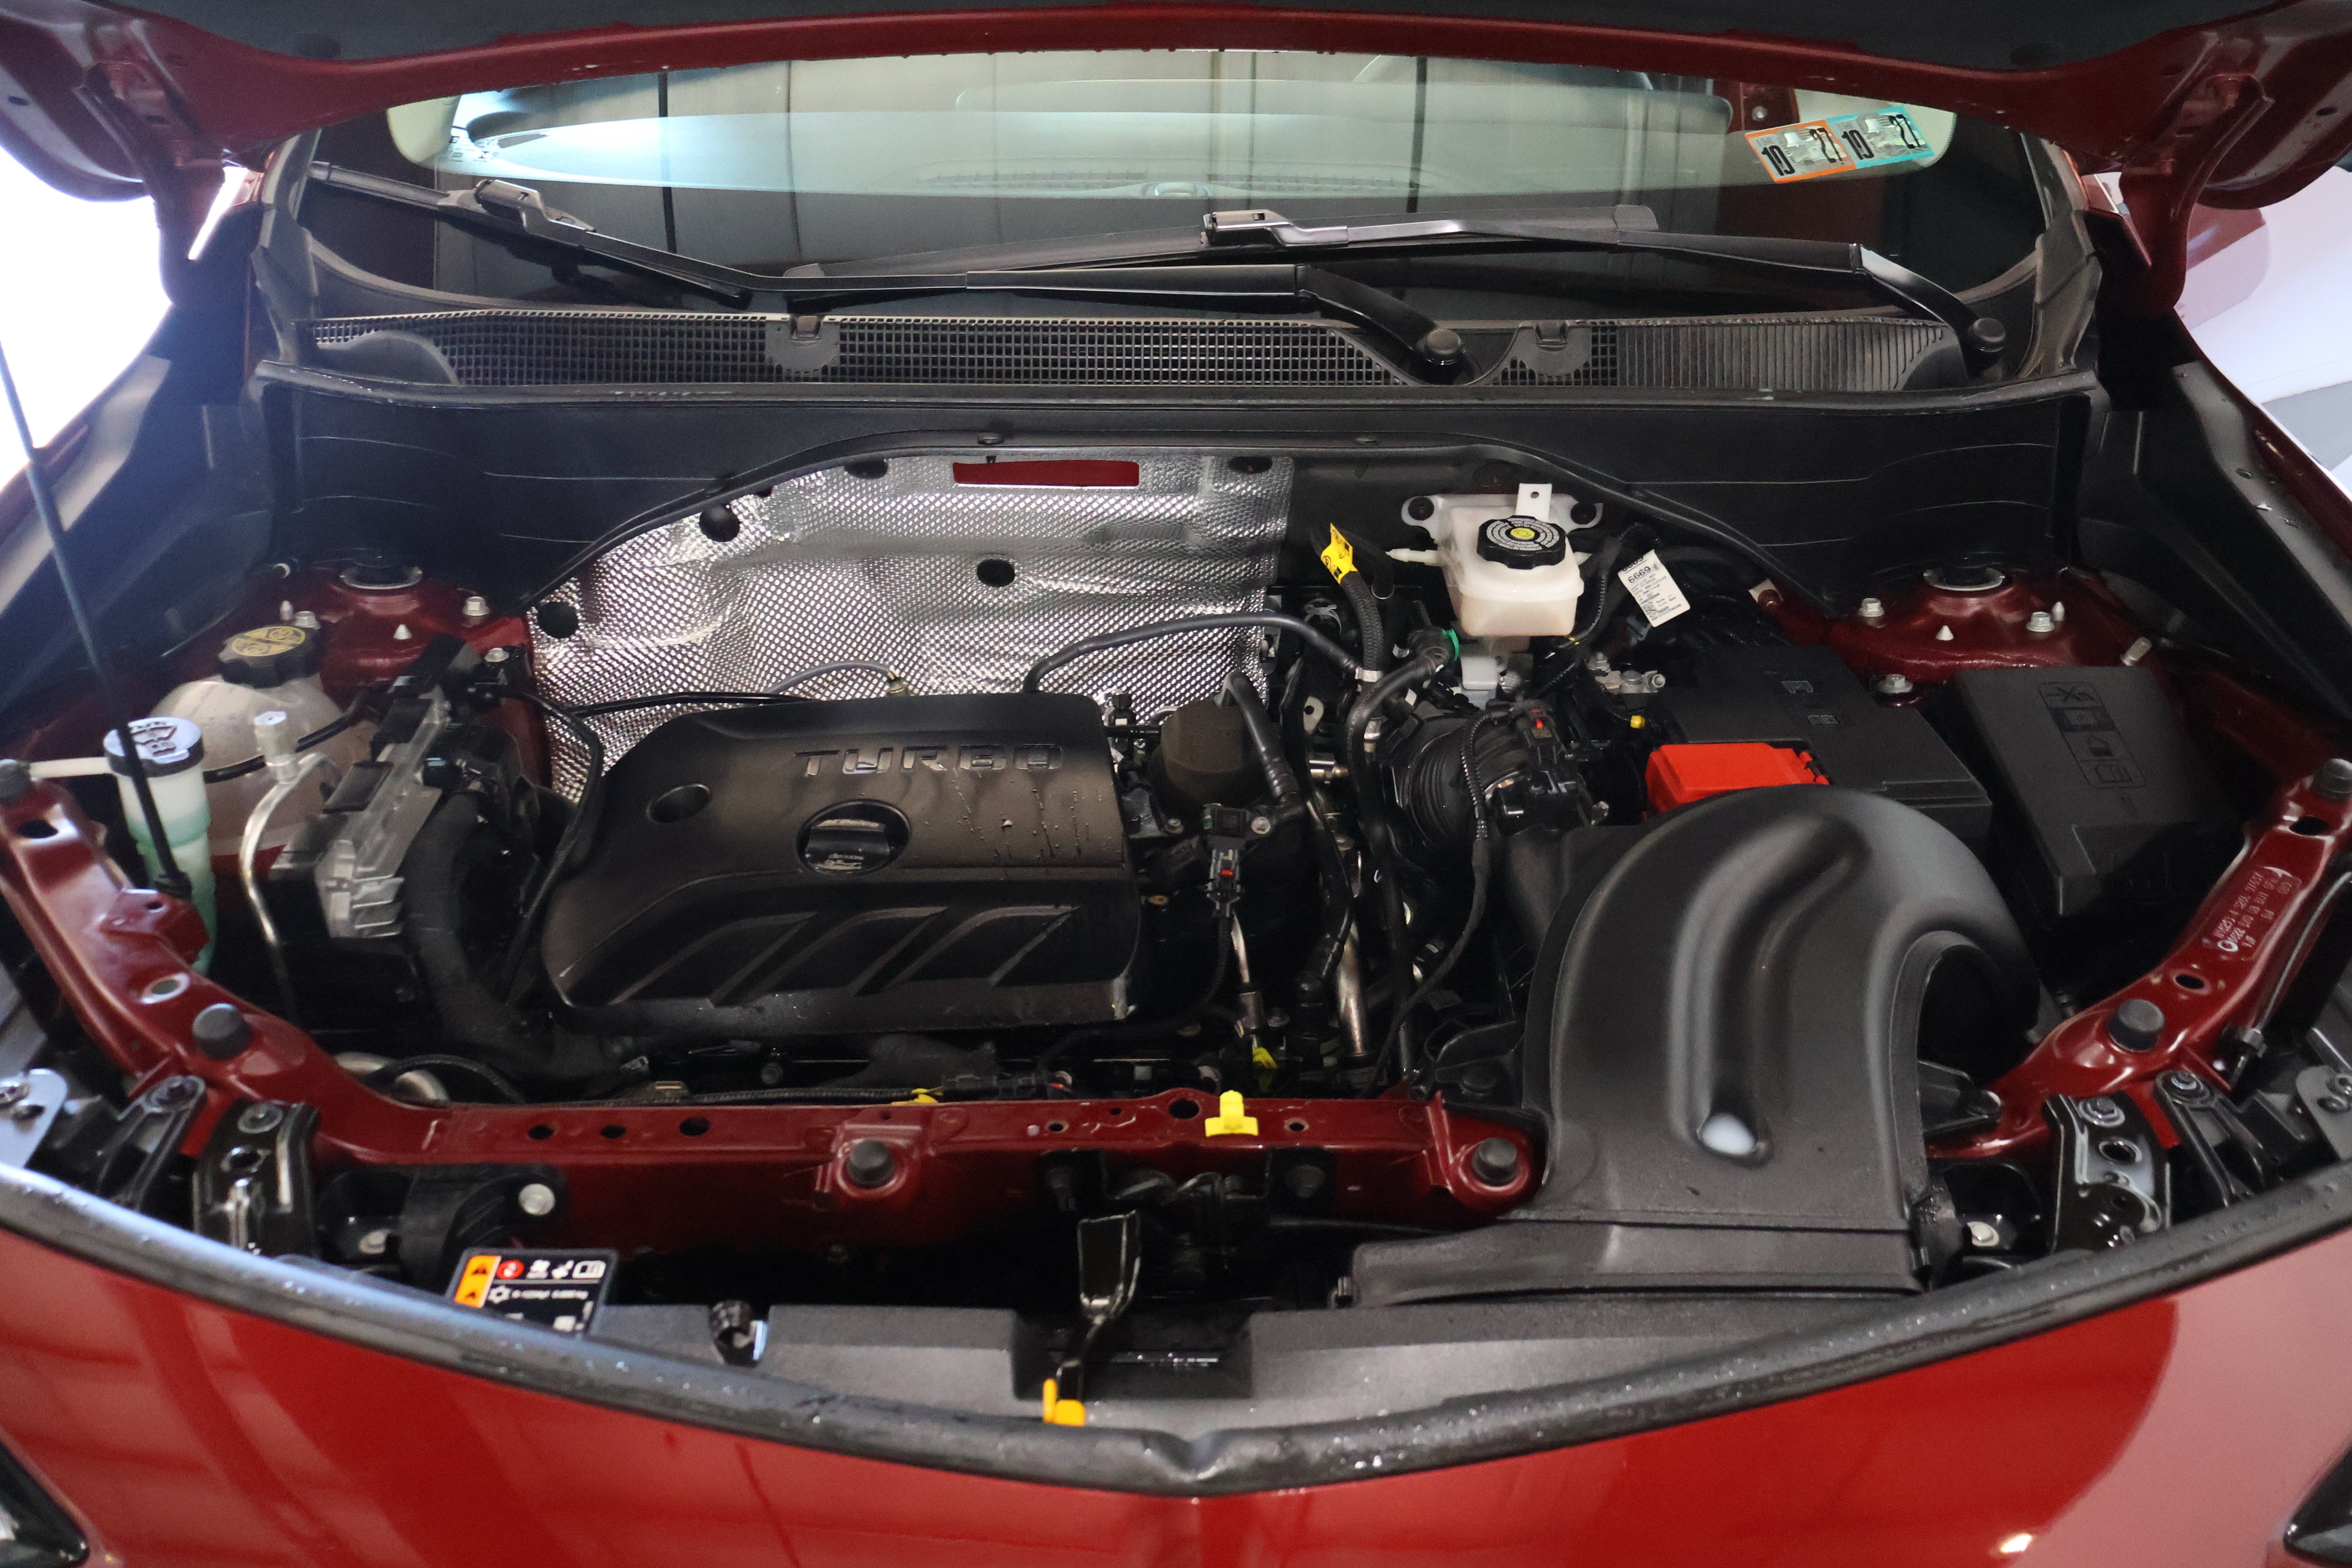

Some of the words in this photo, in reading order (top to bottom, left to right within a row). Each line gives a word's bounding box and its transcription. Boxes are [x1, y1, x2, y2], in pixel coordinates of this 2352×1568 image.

[1842, 130, 1874, 159] 10
[1762, 145, 1795, 176] 10
[1628, 566, 1650, 583] 6669
[795, 744, 1061, 776] TURBO
